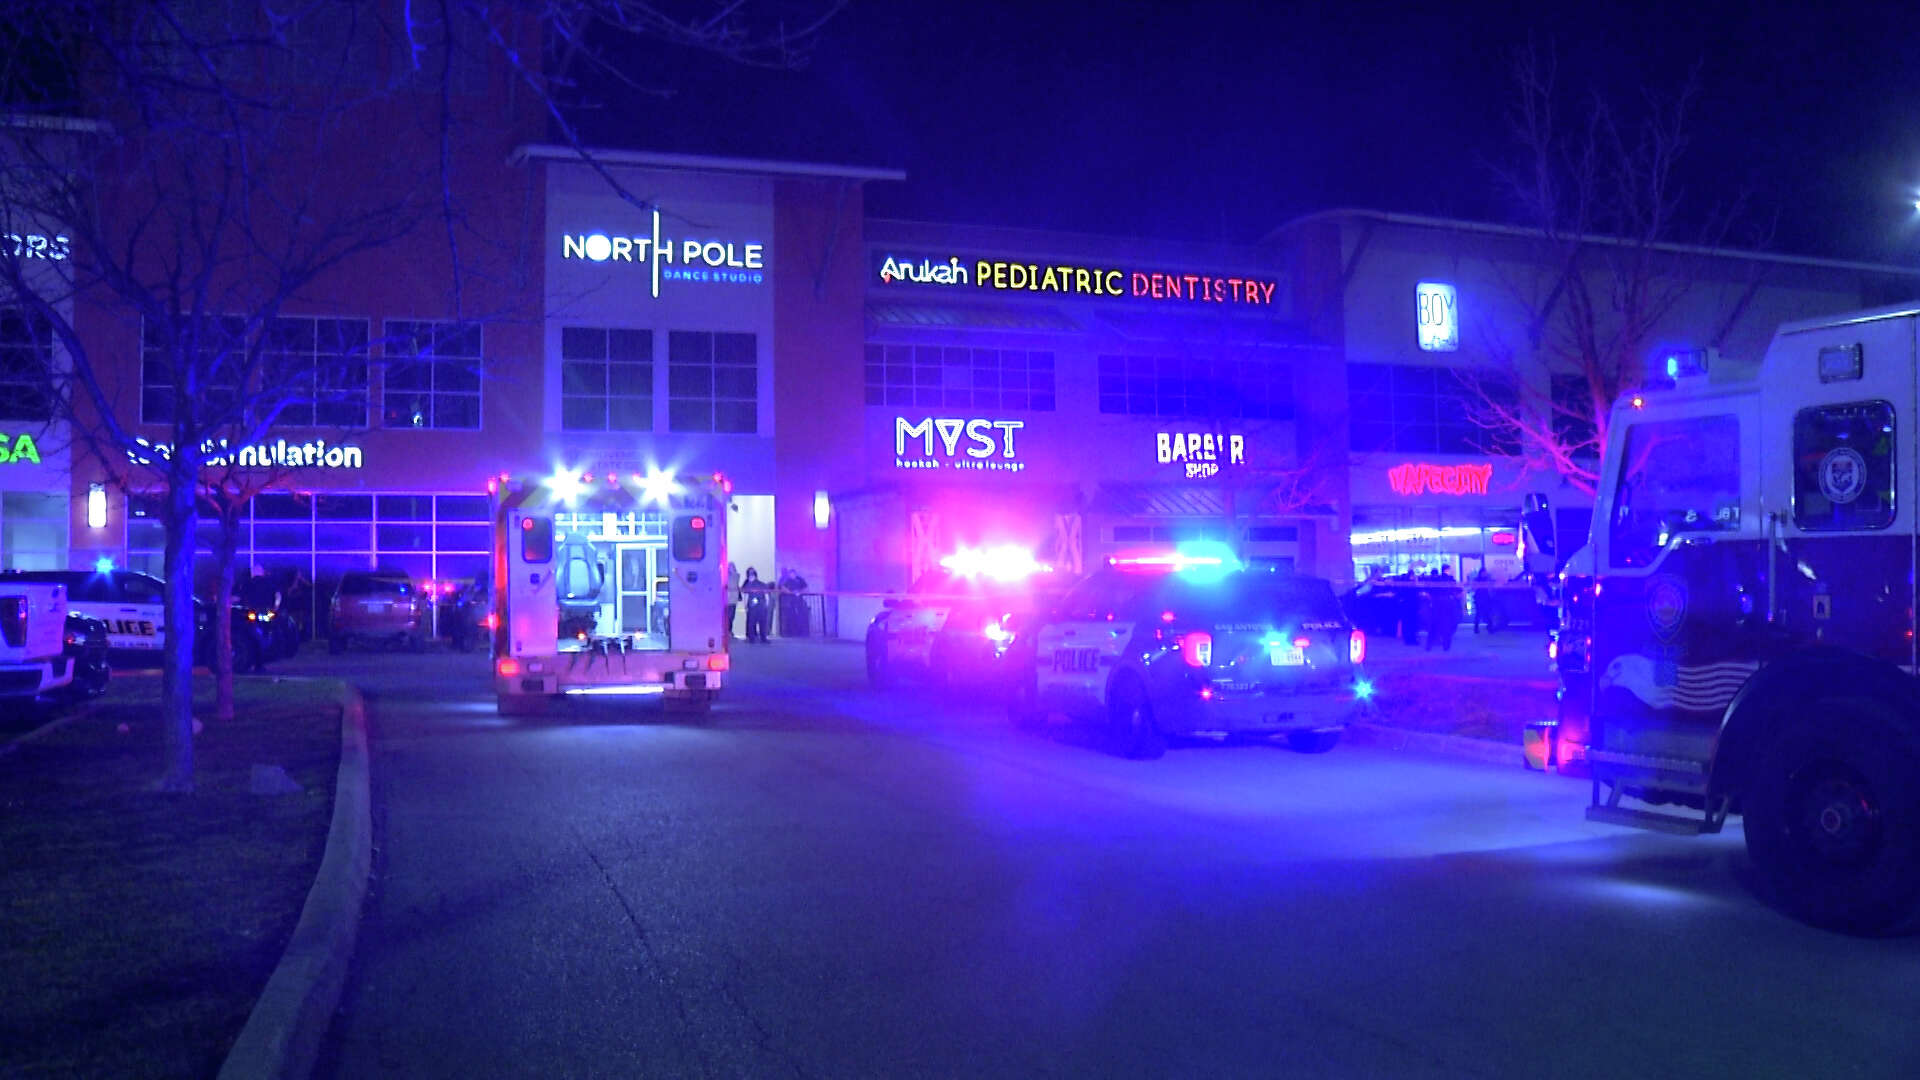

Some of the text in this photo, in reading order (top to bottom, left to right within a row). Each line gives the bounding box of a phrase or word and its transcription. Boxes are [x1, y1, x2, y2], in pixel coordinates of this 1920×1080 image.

[683, 240, 763, 269] POLE
[664, 268, 763, 284] DANCE STUDIO
[880, 256, 1275, 304] Arukah PEDIATRIC DENTISTRY
[1418, 293, 1454, 326] BOY
[895, 457, 940, 469] hookah
[1054, 647, 1101, 673] POLICE
